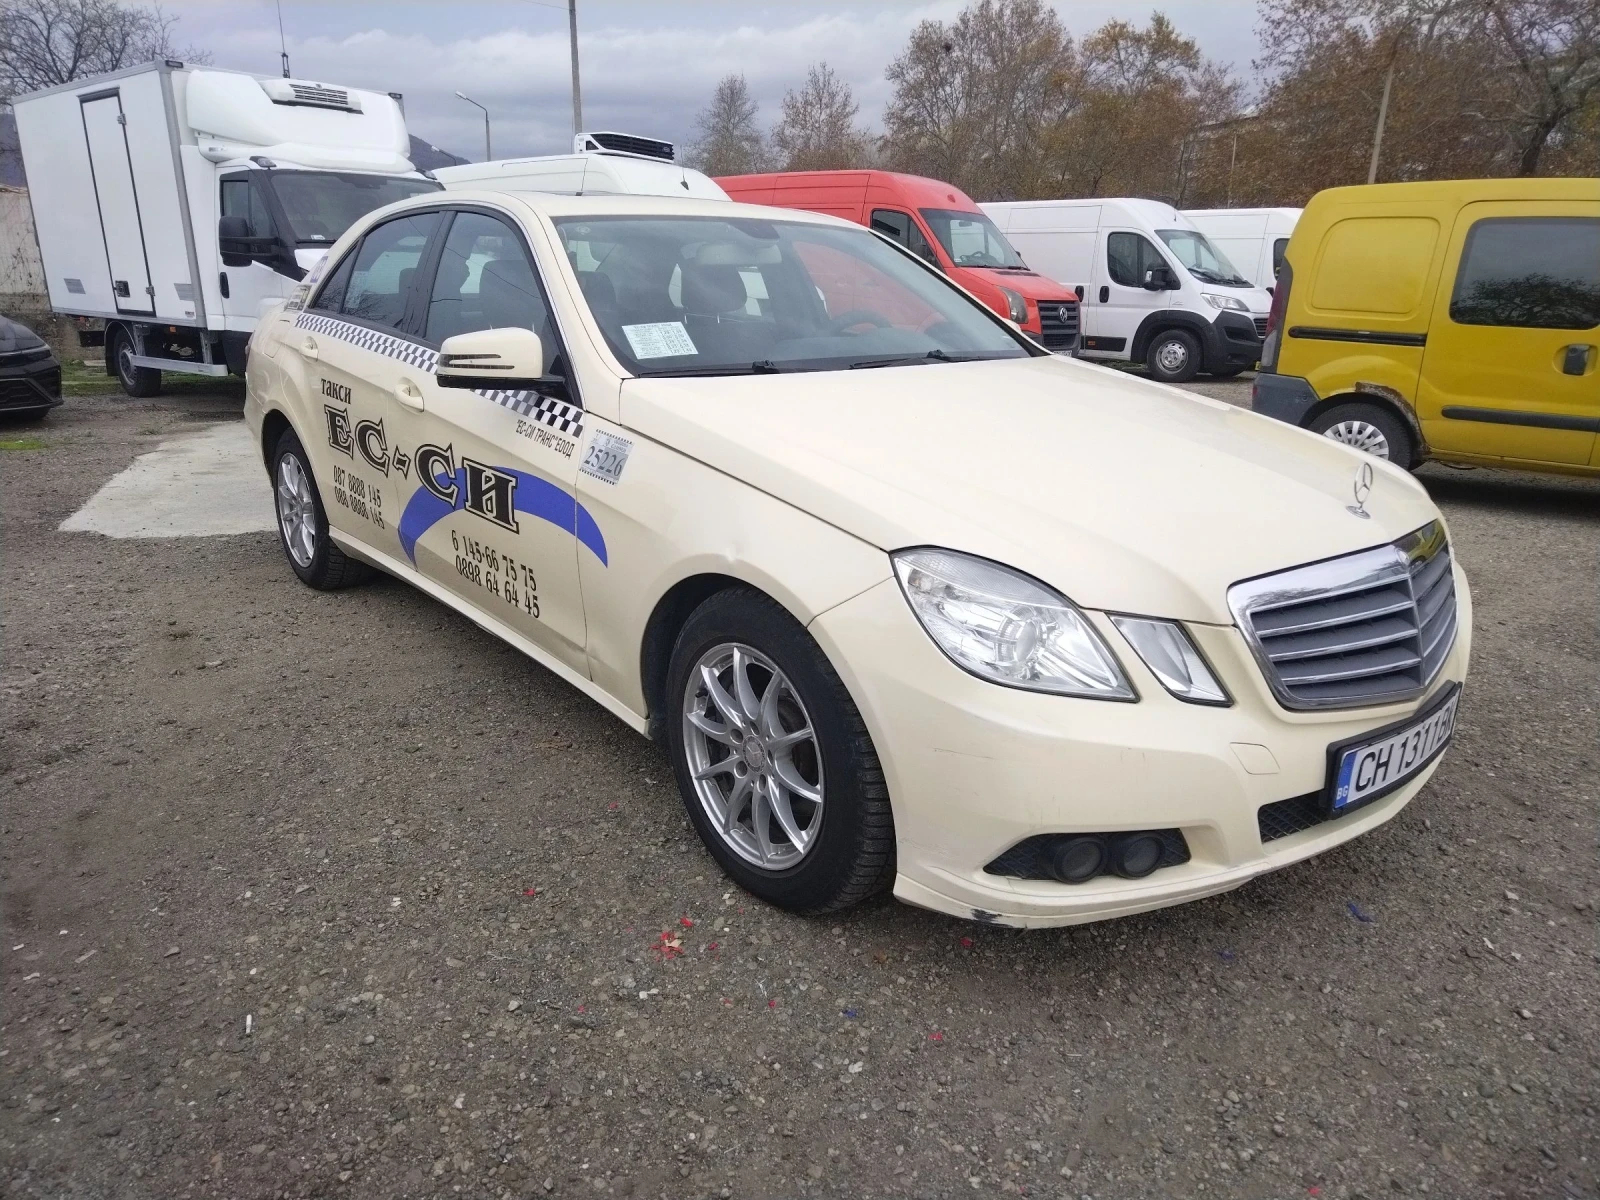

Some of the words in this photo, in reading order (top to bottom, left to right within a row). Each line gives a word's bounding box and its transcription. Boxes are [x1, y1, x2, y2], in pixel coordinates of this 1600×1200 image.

[321, 378, 352, 404] такси
[554, 438, 575, 460] ЕООД
[583, 445, 625, 477] 25226
[324, 404, 520, 535] ЕС-СИ
[333, 464, 346, 488] 087
[348, 473, 366, 499] 8888
[368, 484, 382, 508] 145
[370, 506, 385, 530] 145
[451, 529, 459, 552] 6
[502, 554, 518, 582] 75
[520, 563, 537, 592] 75
[455, 554, 482, 587] 0898
[485, 570, 500, 597] 64
[504, 580, 519, 608] 64
[524, 589, 540, 619] 45
[1355, 743, 1395, 793] CH
[1397, 714, 1441, 775] 1311
[1336, 785, 1349, 801] BG
